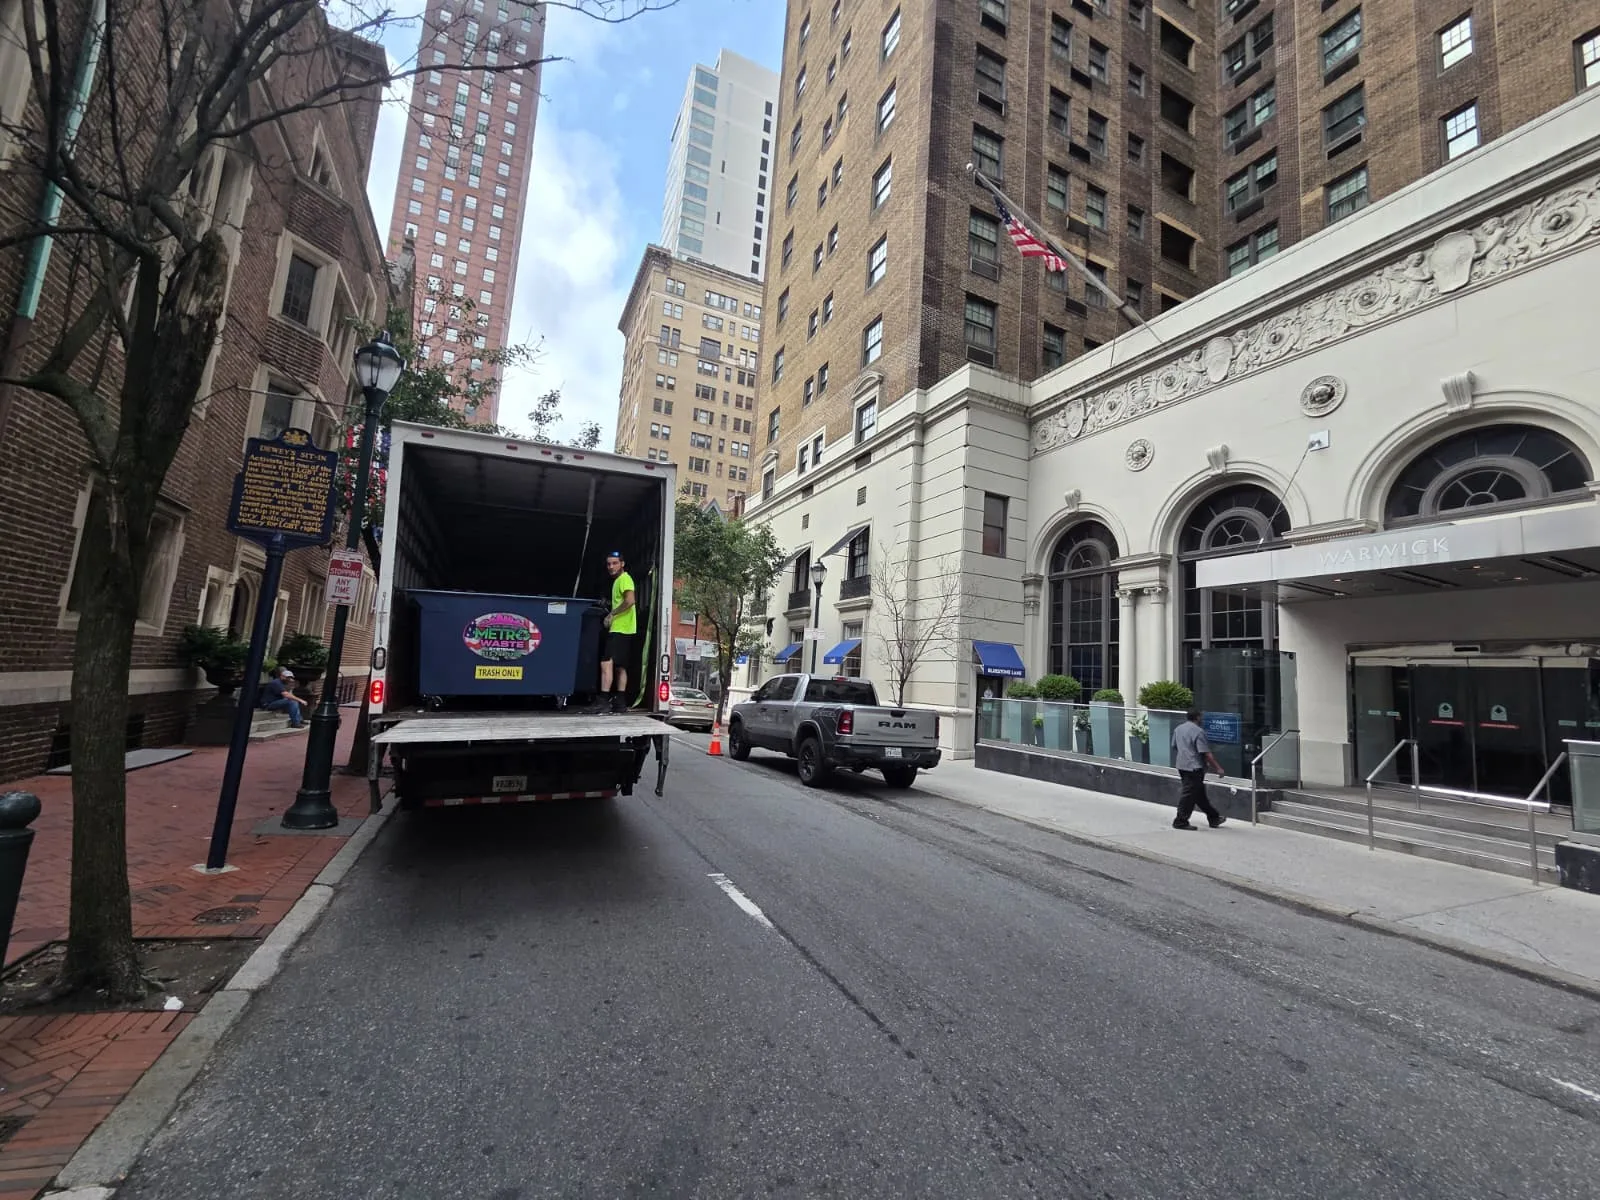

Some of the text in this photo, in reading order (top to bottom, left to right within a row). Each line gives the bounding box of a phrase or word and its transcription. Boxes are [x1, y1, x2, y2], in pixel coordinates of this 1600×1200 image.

[1319, 536, 1449, 565] WARWICK
[343, 560, 351, 568] NO
[330, 567, 360, 577] STOPPING
[336, 578, 350, 586] ANY
[335, 586, 351, 594] TIME
[480, 639, 525, 649] WASTE
[478, 668, 501, 677] TRASH
[502, 668, 520, 677] ONLY
[878, 721, 917, 729] RAM
